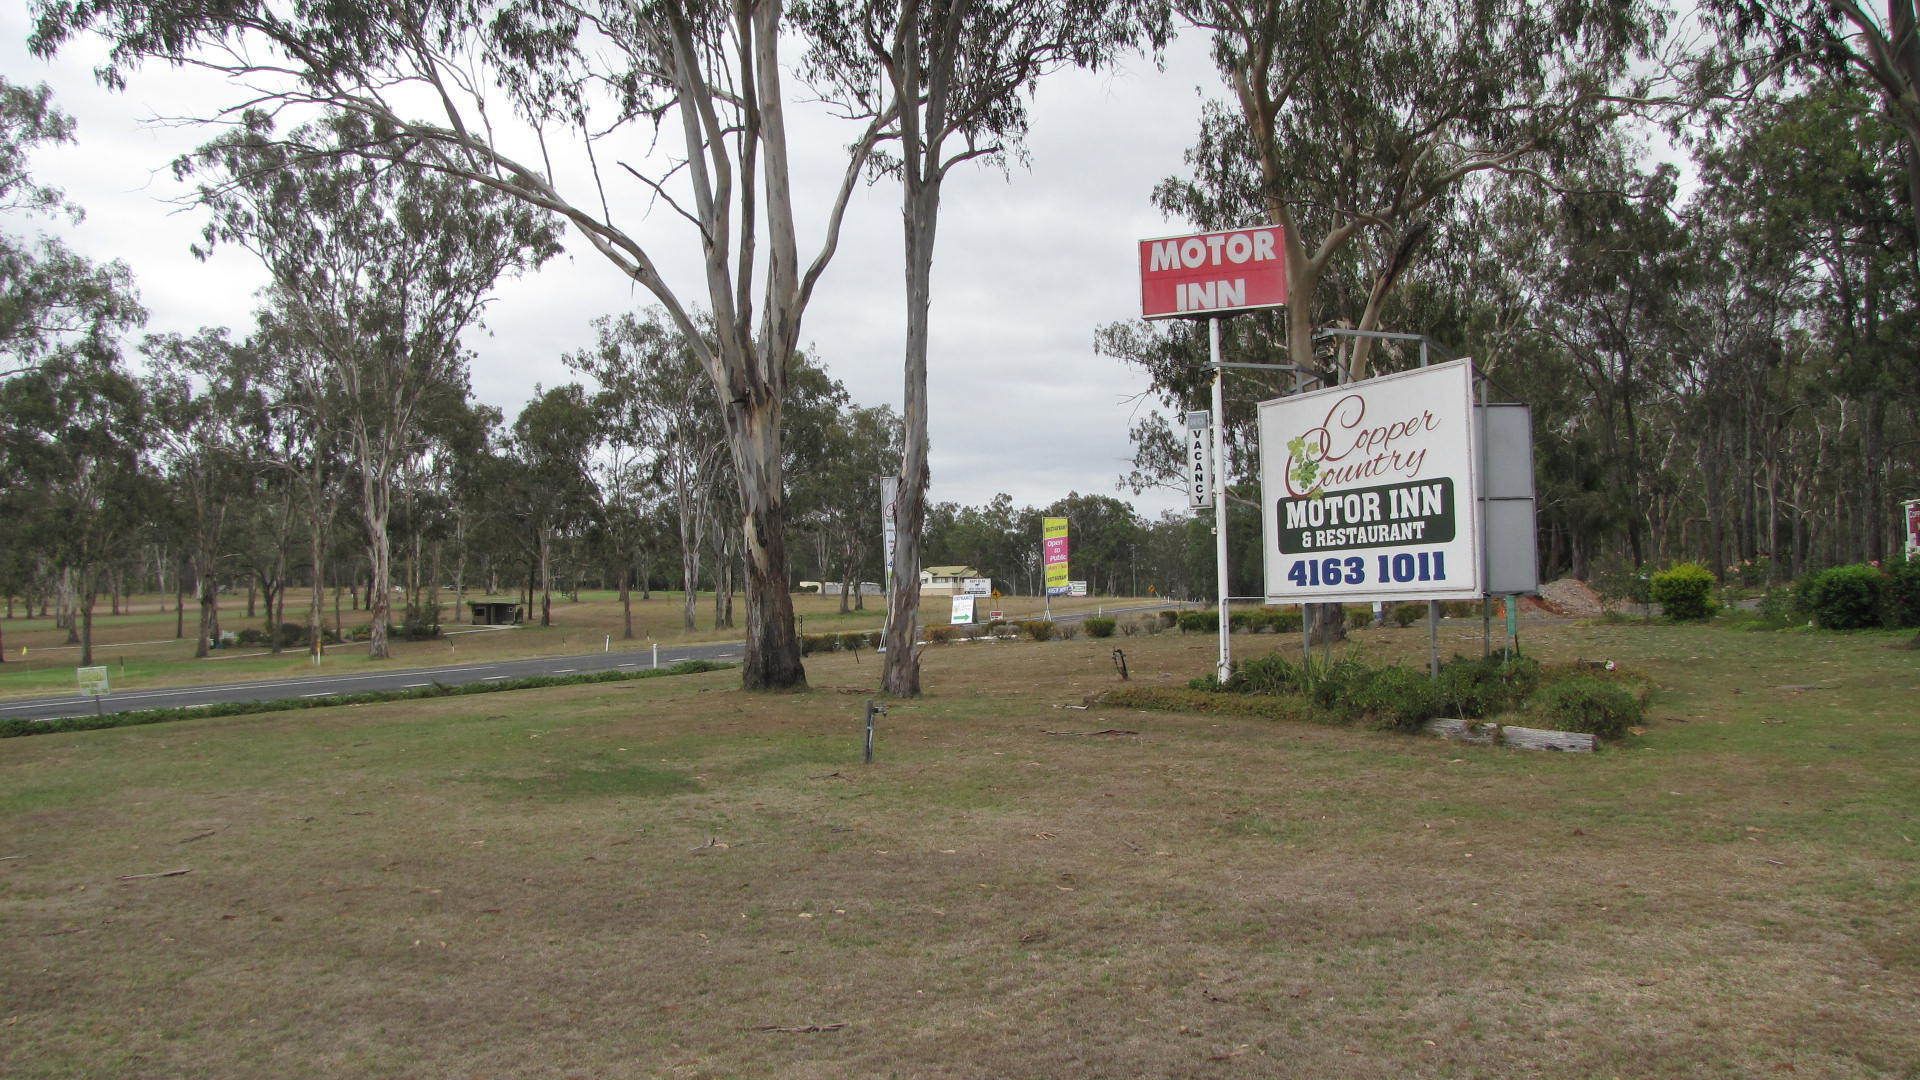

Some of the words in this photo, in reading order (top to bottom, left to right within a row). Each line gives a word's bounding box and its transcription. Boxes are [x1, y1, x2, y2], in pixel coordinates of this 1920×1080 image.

[1149, 231, 1277, 272] MOTOR
[1175, 278, 1246, 311] INN
[1319, 394, 1442, 462] Copper
[1193, 430, 1204, 504] VACANCY
[1285, 427, 1427, 499] Country
[1285, 492, 1382, 530] MOTOR
[1388, 484, 1443, 520] INN
[1301, 531, 1312, 548] &
[1315, 520, 1425, 547] RESTAURANT
[1287, 556, 1365, 587] 4163
[1377, 551, 1446, 583] 1011
